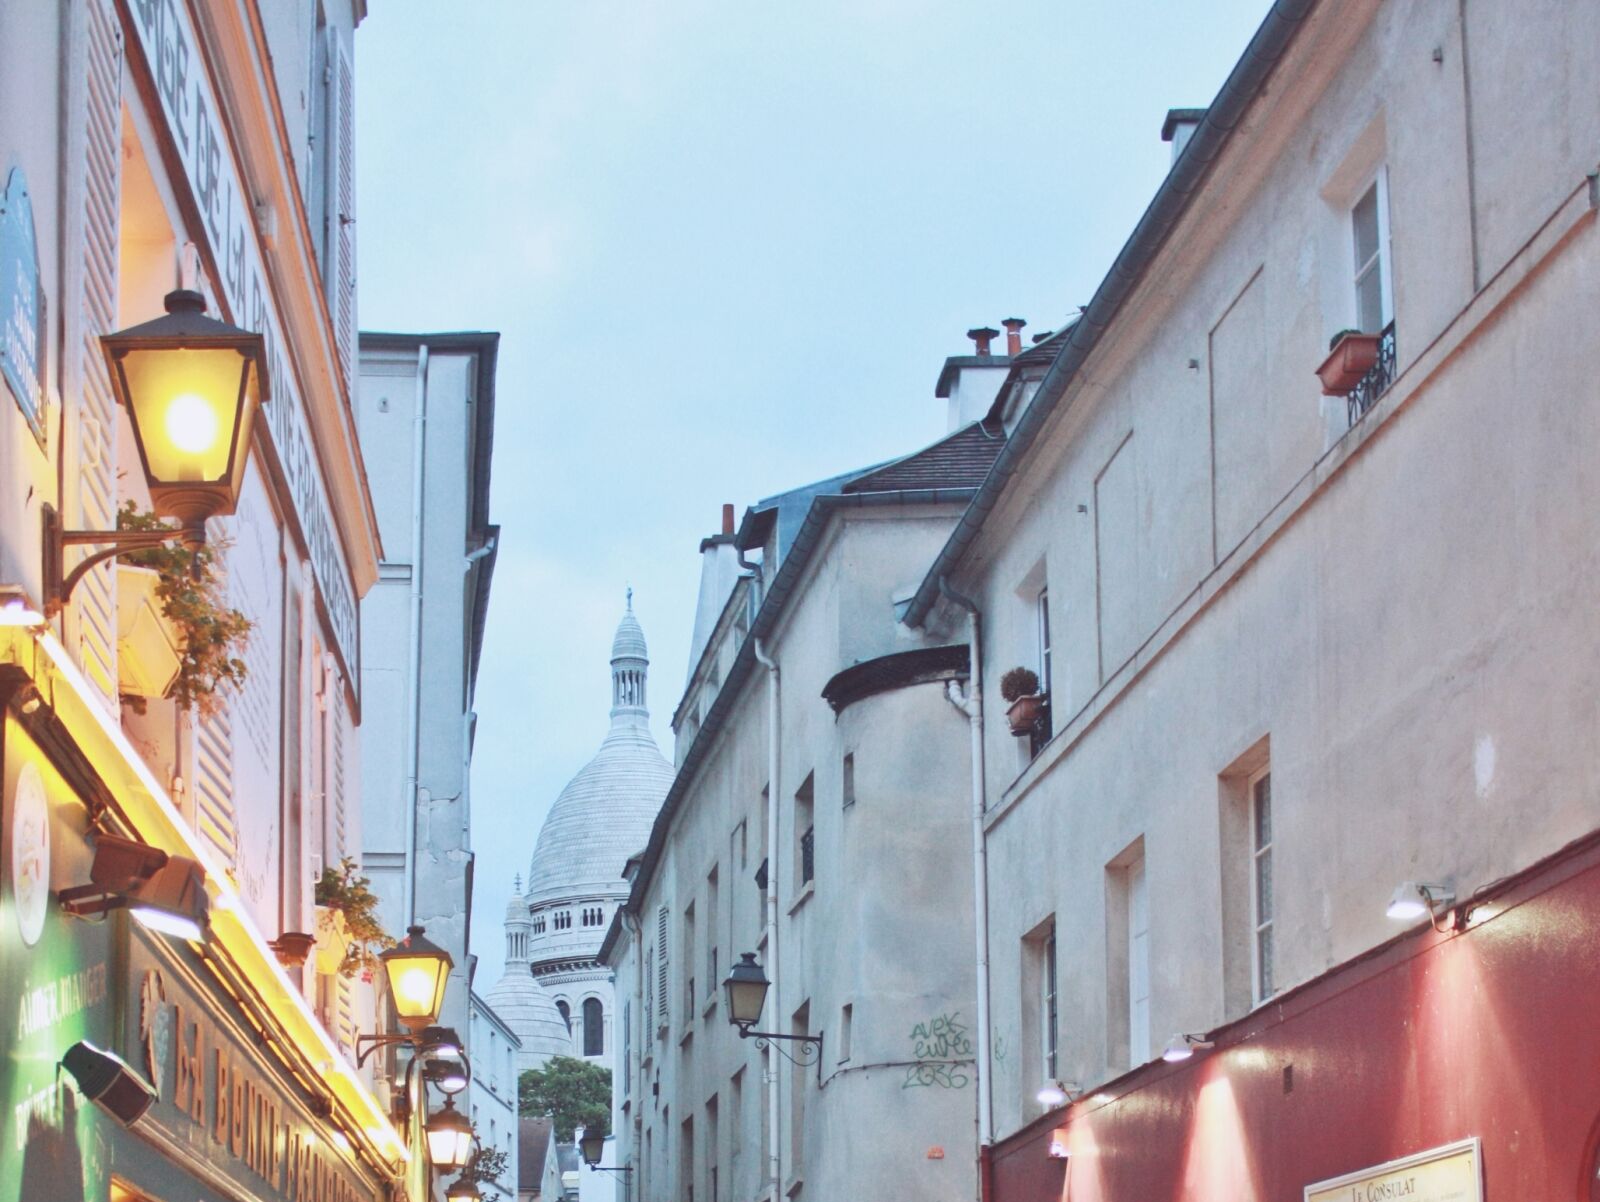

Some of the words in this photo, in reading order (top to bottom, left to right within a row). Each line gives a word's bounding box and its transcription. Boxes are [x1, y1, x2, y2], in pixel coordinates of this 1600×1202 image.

[196, 80, 221, 252] DE
[227, 180, 246, 332] LA
[174, 1004, 206, 1127] LA
[215, 1047, 281, 1192] BONNE
